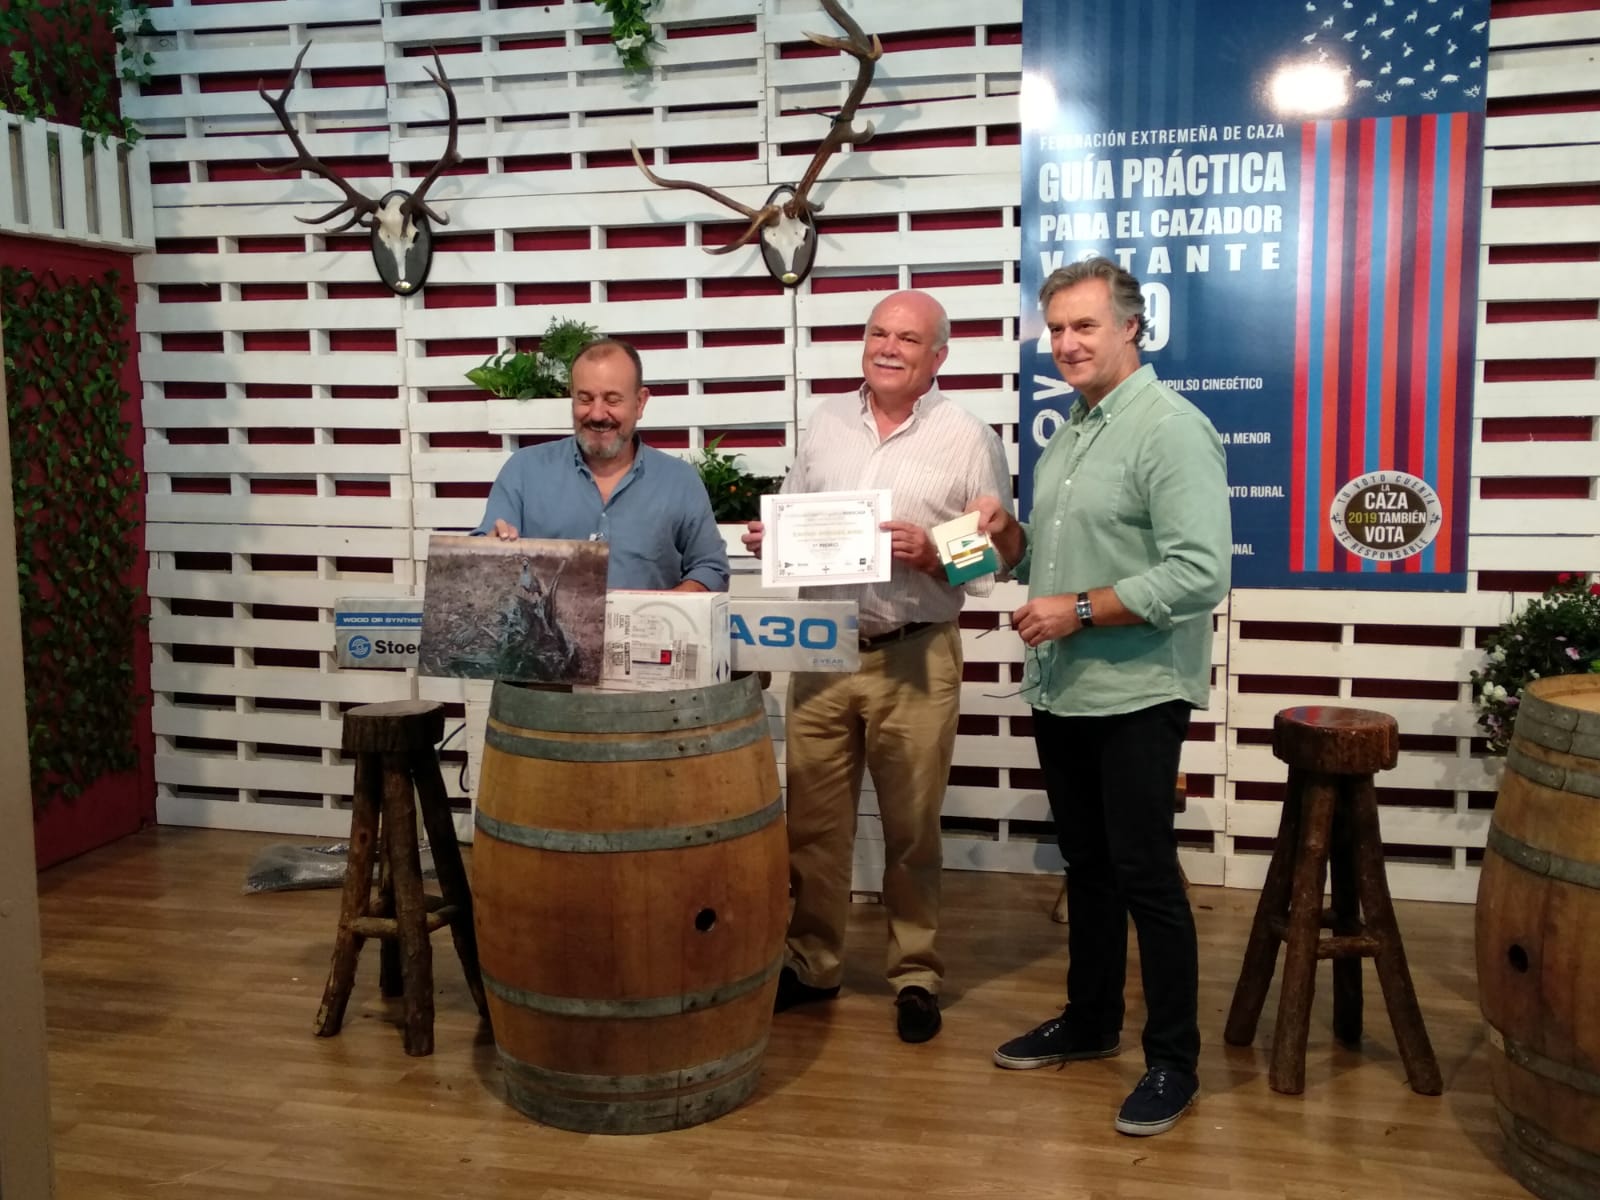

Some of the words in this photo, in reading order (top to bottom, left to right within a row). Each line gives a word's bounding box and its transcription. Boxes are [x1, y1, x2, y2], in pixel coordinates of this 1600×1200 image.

[1131, 125, 1218, 146] EXTREMEÑA
[1223, 125, 1241, 141] DE
[1247, 124, 1284, 139] CAZA
[1039, 153, 1115, 202] GUÍA
[1122, 149, 1287, 199] PRÁCTICA
[1039, 212, 1110, 242] PARA
[1116, 211, 1144, 239] EL
[1150, 205, 1283, 237] CAZADOR
[1039, 242, 1281, 279] VTANTE
[1202, 376, 1263, 391] CINEGÉTICO
[1233, 432, 1271, 444] MENOR
[1250, 485, 1285, 498] RURAL
[1353, 474, 1386, 489] VOTO
[1395, 474, 1435, 505] CUENTA
[1364, 491, 1408, 510] CAZA
[1348, 511, 1377, 524] 2019
[1378, 510, 1427, 524] TAMBIÉN
[1364, 525, 1405, 543] VOTA
